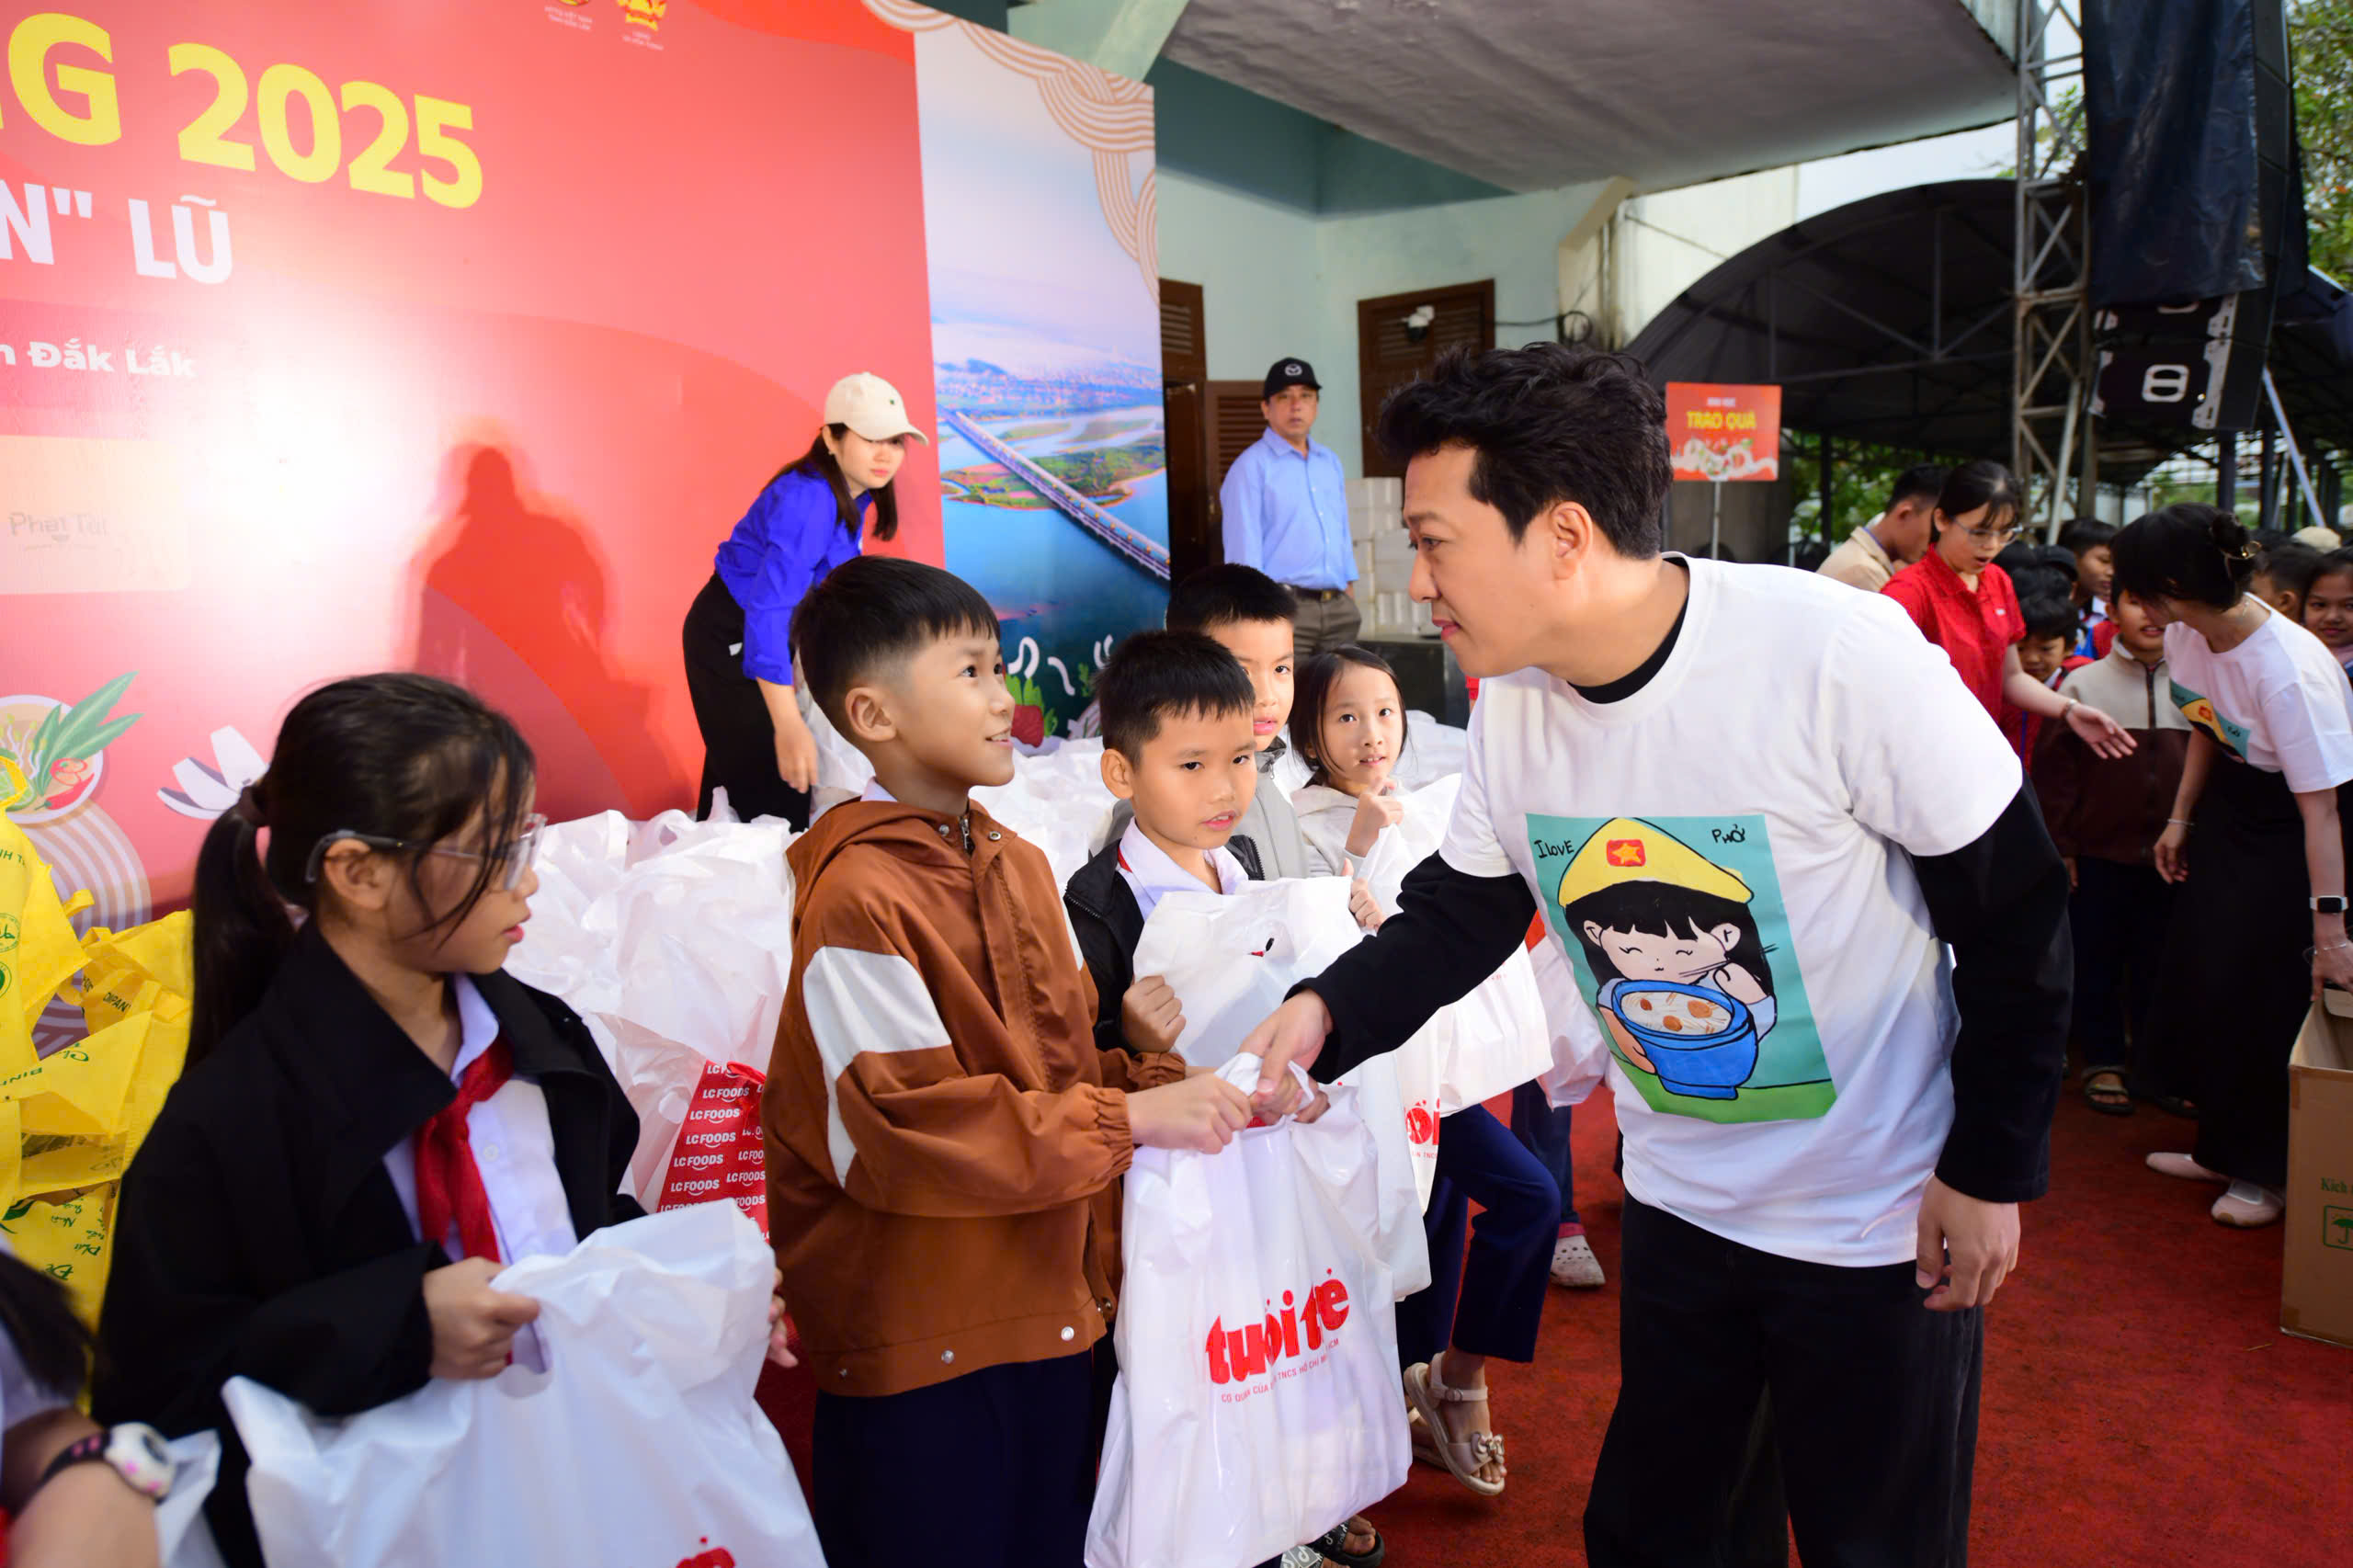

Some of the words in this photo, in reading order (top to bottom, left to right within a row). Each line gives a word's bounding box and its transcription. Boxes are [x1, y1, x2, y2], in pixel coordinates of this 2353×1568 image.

[0, 13, 121, 146] G
[168, 42, 483, 210] 2025
[128, 194, 233, 284] LŨ
[28, 337, 115, 372] Đắk
[125, 345, 197, 378] Lắk
[1687, 411, 1722, 429] TRAO
[702, 1088, 716, 1098] LC
[717, 1087, 750, 1097] FOODS
[690, 1109, 703, 1119] LC
[704, 1108, 740, 1119] FOODS
[686, 1134, 699, 1144] LC
[699, 1132, 736, 1143] FOODS
[674, 1156, 687, 1167] LC
[687, 1154, 724, 1165] FOODS
[738, 1150, 748, 1161] LC
[749, 1149, 765, 1160] FOO
[726, 1173, 738, 1183] LC
[739, 1171, 766, 1182] FOODS
[671, 1182, 683, 1192] LC
[684, 1179, 720, 1191] FOODS
